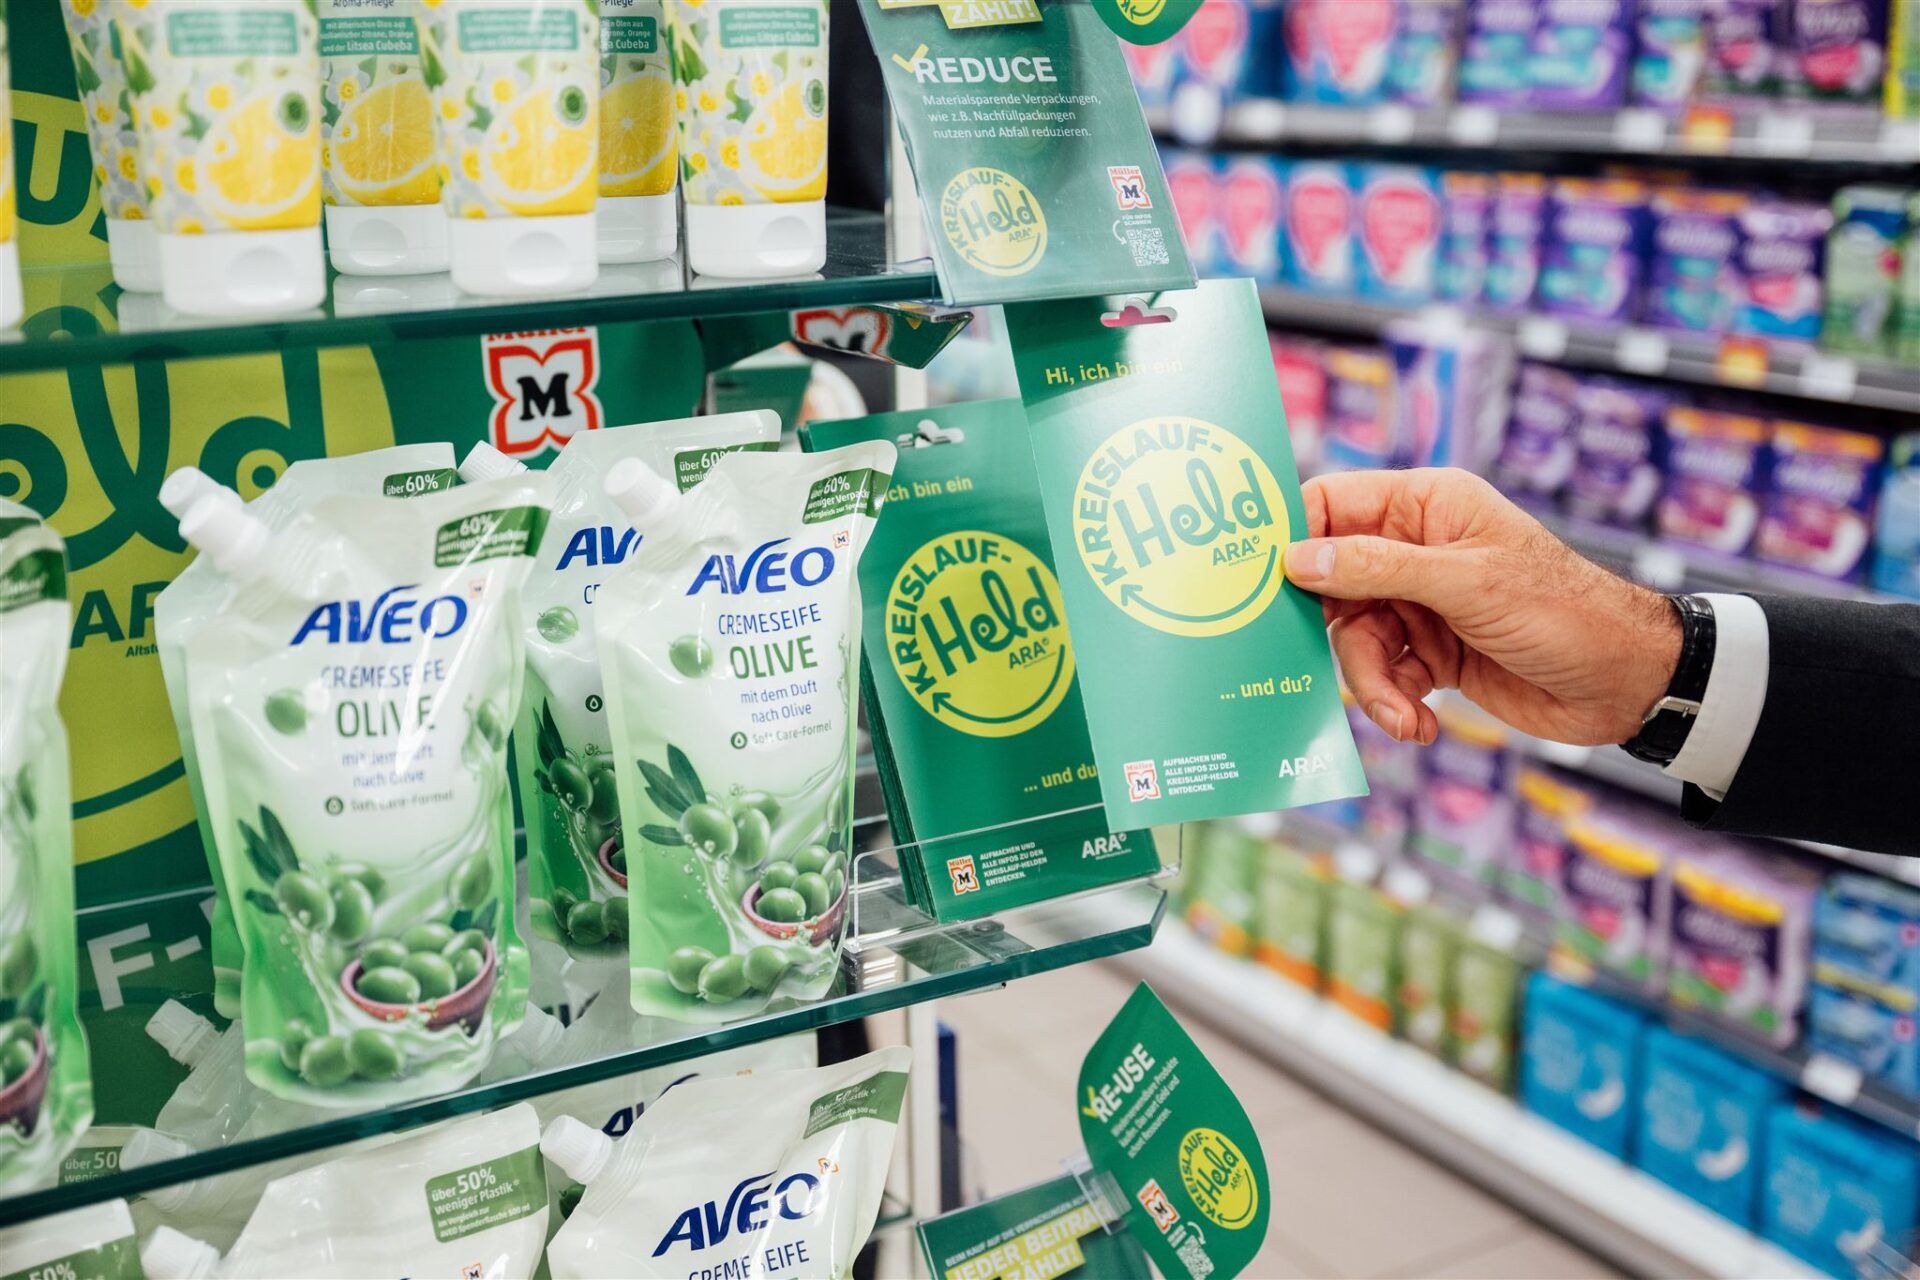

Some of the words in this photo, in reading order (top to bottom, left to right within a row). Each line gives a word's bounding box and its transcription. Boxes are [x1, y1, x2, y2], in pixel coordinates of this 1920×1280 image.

[347, 41, 374, 51] Litsea
[375, 40, 413, 51] Cubeba
[616, 39, 650, 49] Cubeba
[912, 56, 1058, 84] REDUCE
[922, 93, 1021, 107] Materialsparende
[1022, 93, 1102, 107] Verpackungen,
[928, 112, 948, 122] wie
[952, 111, 971, 122] z.B.
[974, 109, 1076, 124] Nachfüllpackungen
[933, 128, 972, 139] nutzen
[975, 127, 996, 138] und
[999, 126, 1030, 138] Abfall
[1032, 126, 1092, 137] reduzieren.
[1122, 185, 1141, 199] M
[943, 171, 1011, 249] KREISLAUF-
[960, 188, 1038, 242] Held
[1045, 366, 1075, 385] Hi,
[1079, 363, 1110, 381] ich
[1115, 361, 1147, 378] bin
[516, 372, 573, 422] M
[680, 461, 700, 471] über
[681, 471, 708, 483] weni
[387, 485, 405, 495] über
[405, 473, 439, 493] 60%
[824, 475, 851, 494] 60%
[912, 480, 942, 498] bin
[946, 475, 973, 493] ein
[1080, 422, 1224, 587] KREISLAUF-
[1112, 457, 1273, 568] Held
[460, 514, 496, 537] 60%
[555, 526, 644, 571] AV
[1213, 538, 1256, 566] ARA
[686, 536, 835, 596] AVEO
[289, 584, 468, 646] AVEO
[718, 603, 822, 636] CREMESEIFE
[891, 537, 1012, 696] KREISLAUF-
[920, 566, 1060, 677] Held
[729, 635, 818, 680] OLIVE
[1009, 641, 1046, 669] ARA
[321, 660, 445, 689] CREMESEFE
[1240, 677, 1275, 697] und
[1280, 674, 1313, 694] du?
[740, 690, 759, 704] mit
[760, 686, 789, 704] dem
[790, 680, 818, 697] Duft
[751, 709, 780, 725] nach
[782, 703, 812, 720] Olive
[1163, 754, 1210, 767] AUFMACHEN
[1211, 752, 1227, 761] UND
[1165, 766, 1183, 776] ALLE
[1184, 764, 1208, 774] INFOS
[1209, 763, 1219, 772] ZU
[1220, 761, 1236, 770] DEN
[1279, 755, 1328, 778] ARA
[1042, 766, 1073, 788] und
[1077, 764, 1097, 783] du
[1135, 777, 1151, 791] M
[1166, 770, 1239, 786] KREISLAUF-HELDEN
[1168, 784, 1215, 796] ENTDECKEN.
[980, 845, 1021, 861] AUFMACHEN
[1021, 842, 1036, 851] UND
[1081, 834, 1122, 859] ARA
[982, 859, 999, 870] ALLE
[999, 854, 1019, 866] INFOS
[1020, 852, 1029, 861] ZU
[1029, 849, 1044, 859] DEN
[984, 857, 1048, 878] KREISLAUF-HELDEN
[957, 872, 971, 885] M
[985, 873, 1027, 887] ENTDECKEN.
[1091, 1042, 1156, 1124] RE-USE
[65, 1159, 91, 1170] über
[94, 1151, 121, 1169] 50
[1197, 1136, 1240, 1205] Held
[431, 1186, 457, 1202] über
[456, 1166, 497, 1194] 50%
[1182, 1132, 1217, 1218] KREISLAUF-
[434, 1196, 479, 1216] weniger
[651, 1170, 820, 1258] AVEO
[1025, 1203, 1102, 1255] BEITRA
[689, 1240, 810, 1280] CREMEEIFE
